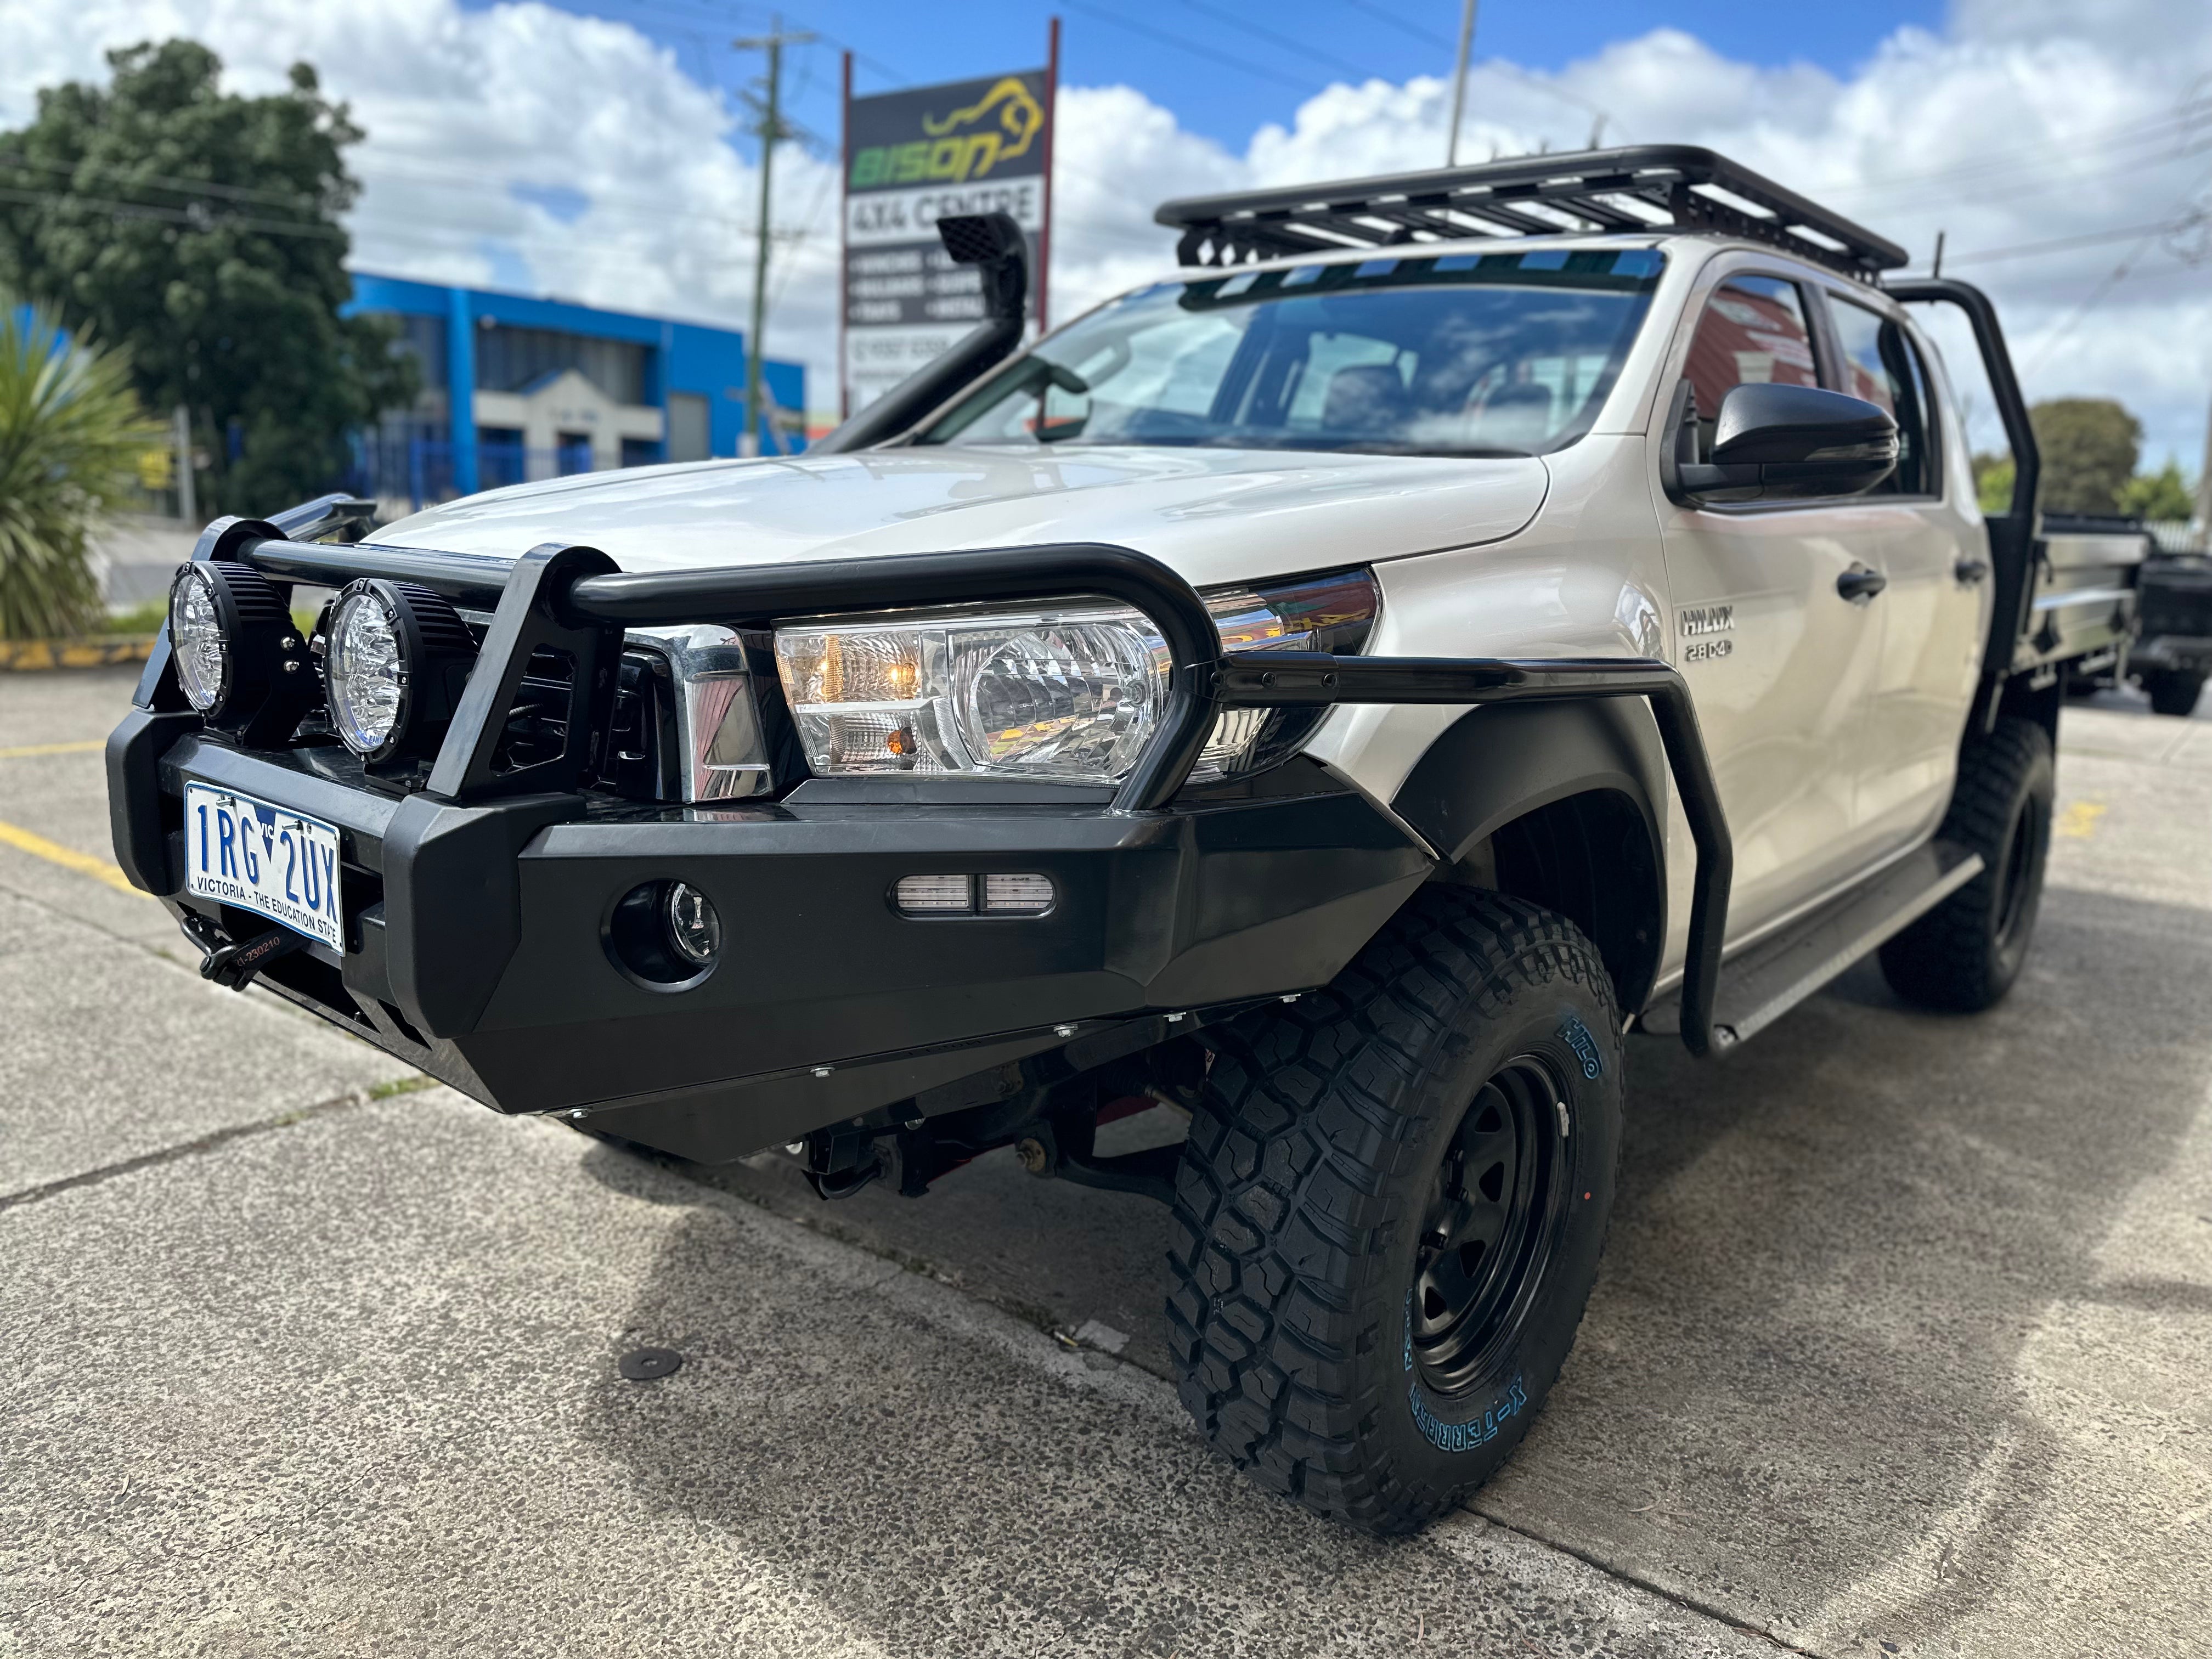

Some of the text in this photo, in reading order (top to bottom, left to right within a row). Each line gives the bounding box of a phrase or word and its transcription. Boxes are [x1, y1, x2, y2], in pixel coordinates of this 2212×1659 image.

[1680, 605, 1735, 636] HILUX
[198, 876, 246, 900] VICTORIA
[254, 891, 270, 910] THE
[272, 899, 315, 930] EDUCATION
[318, 918, 336, 944] STATE
